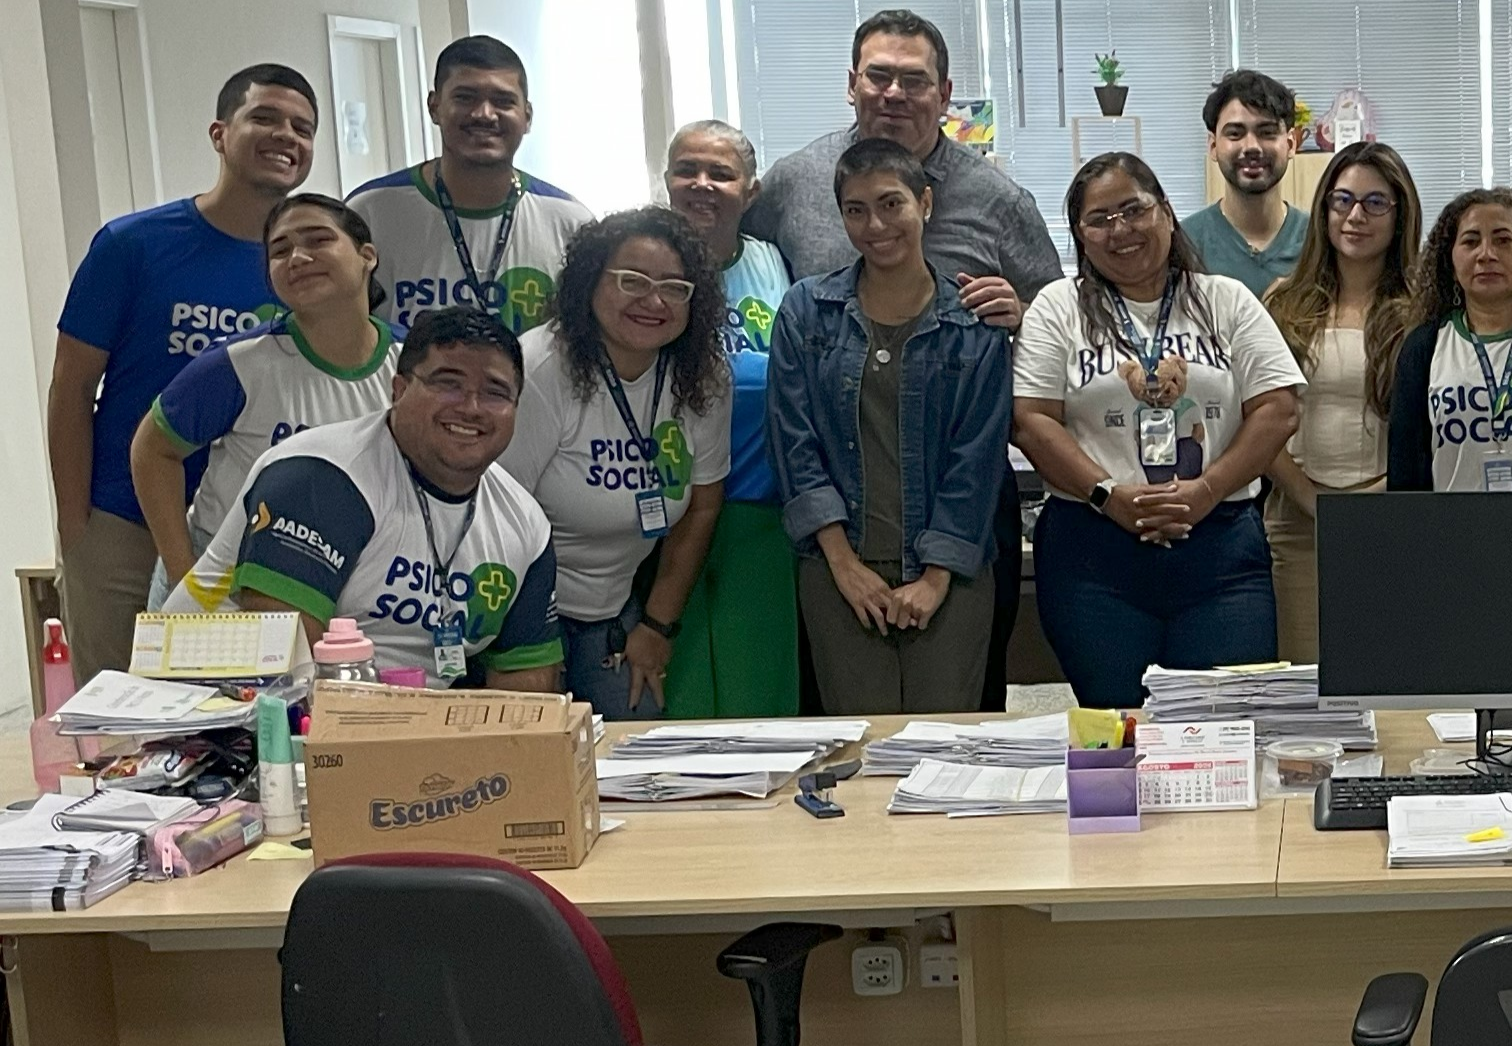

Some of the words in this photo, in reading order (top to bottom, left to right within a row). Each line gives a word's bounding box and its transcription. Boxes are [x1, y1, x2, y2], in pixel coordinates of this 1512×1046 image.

[395, 278, 507, 308] PSICO
[171, 302, 261, 334] PSICO
[312, 754, 344, 769] 30260
[371, 774, 509, 829] Escureto
